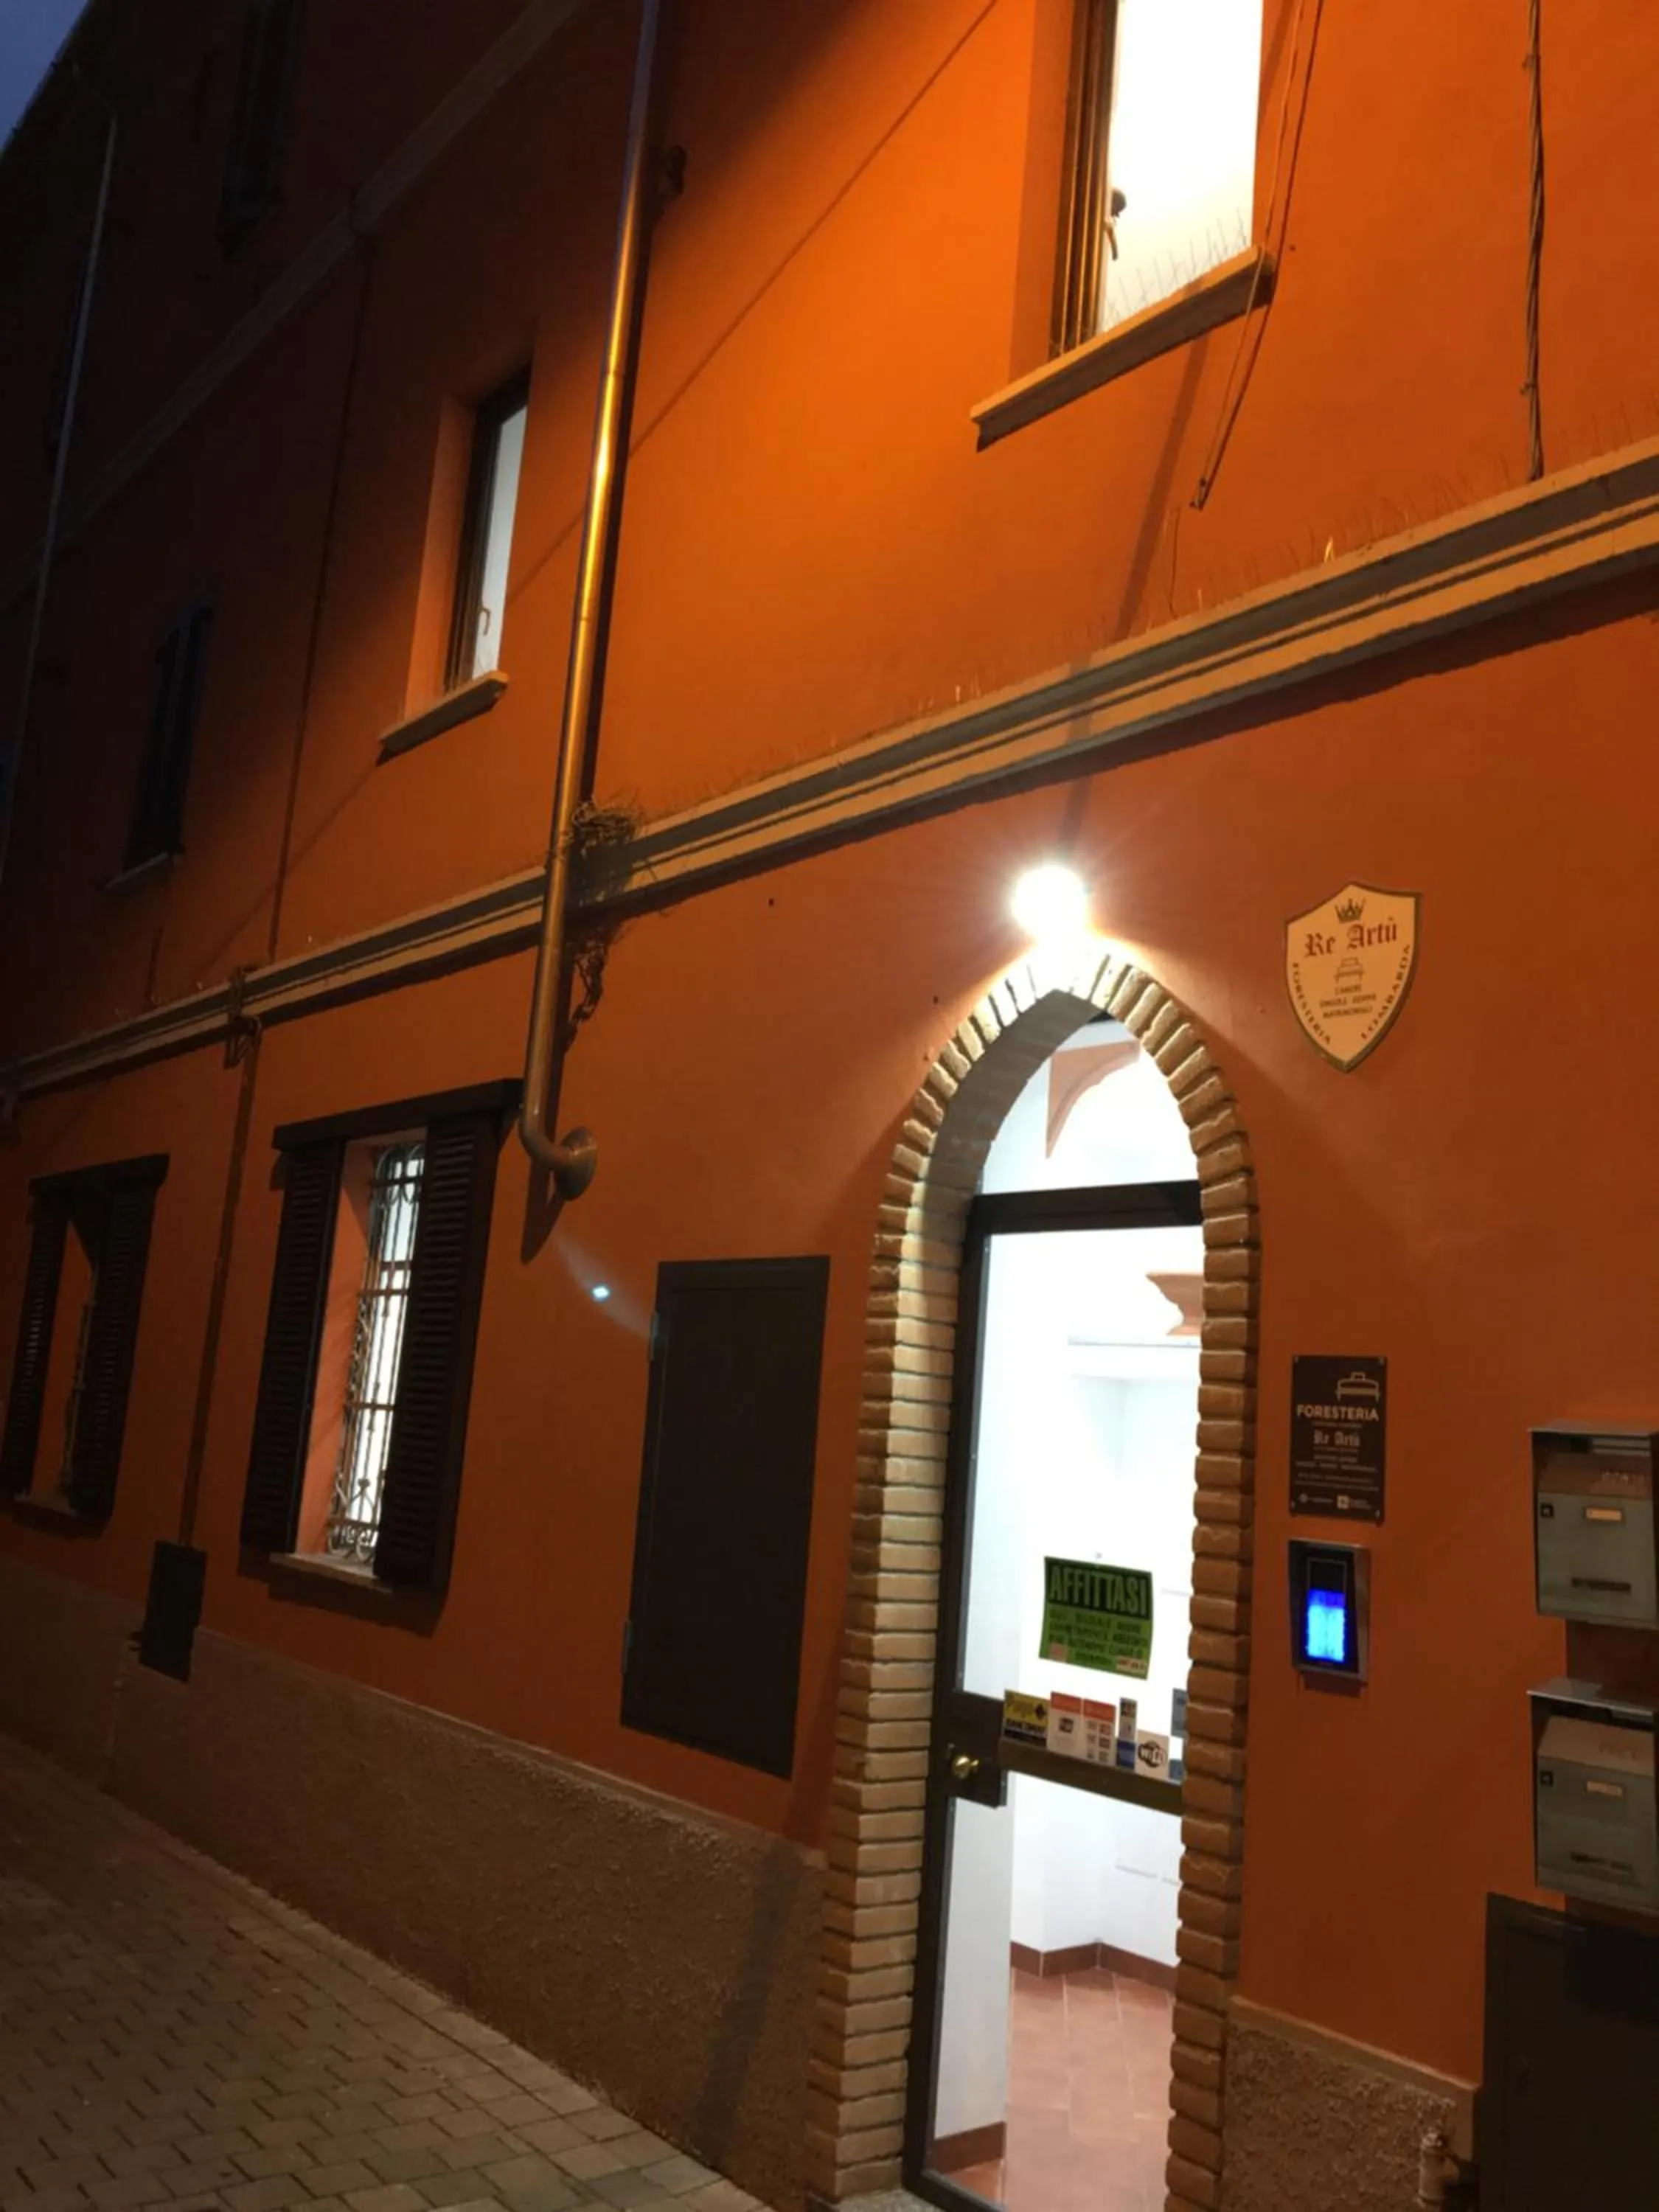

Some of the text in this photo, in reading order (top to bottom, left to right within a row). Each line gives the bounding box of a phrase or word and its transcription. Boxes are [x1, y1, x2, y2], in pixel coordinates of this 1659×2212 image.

[1304, 933, 1336, 958] Re
[1296, 1403, 1380, 1422] FORESTERIA
[1049, 1564, 1148, 1617] AFFITTASI
